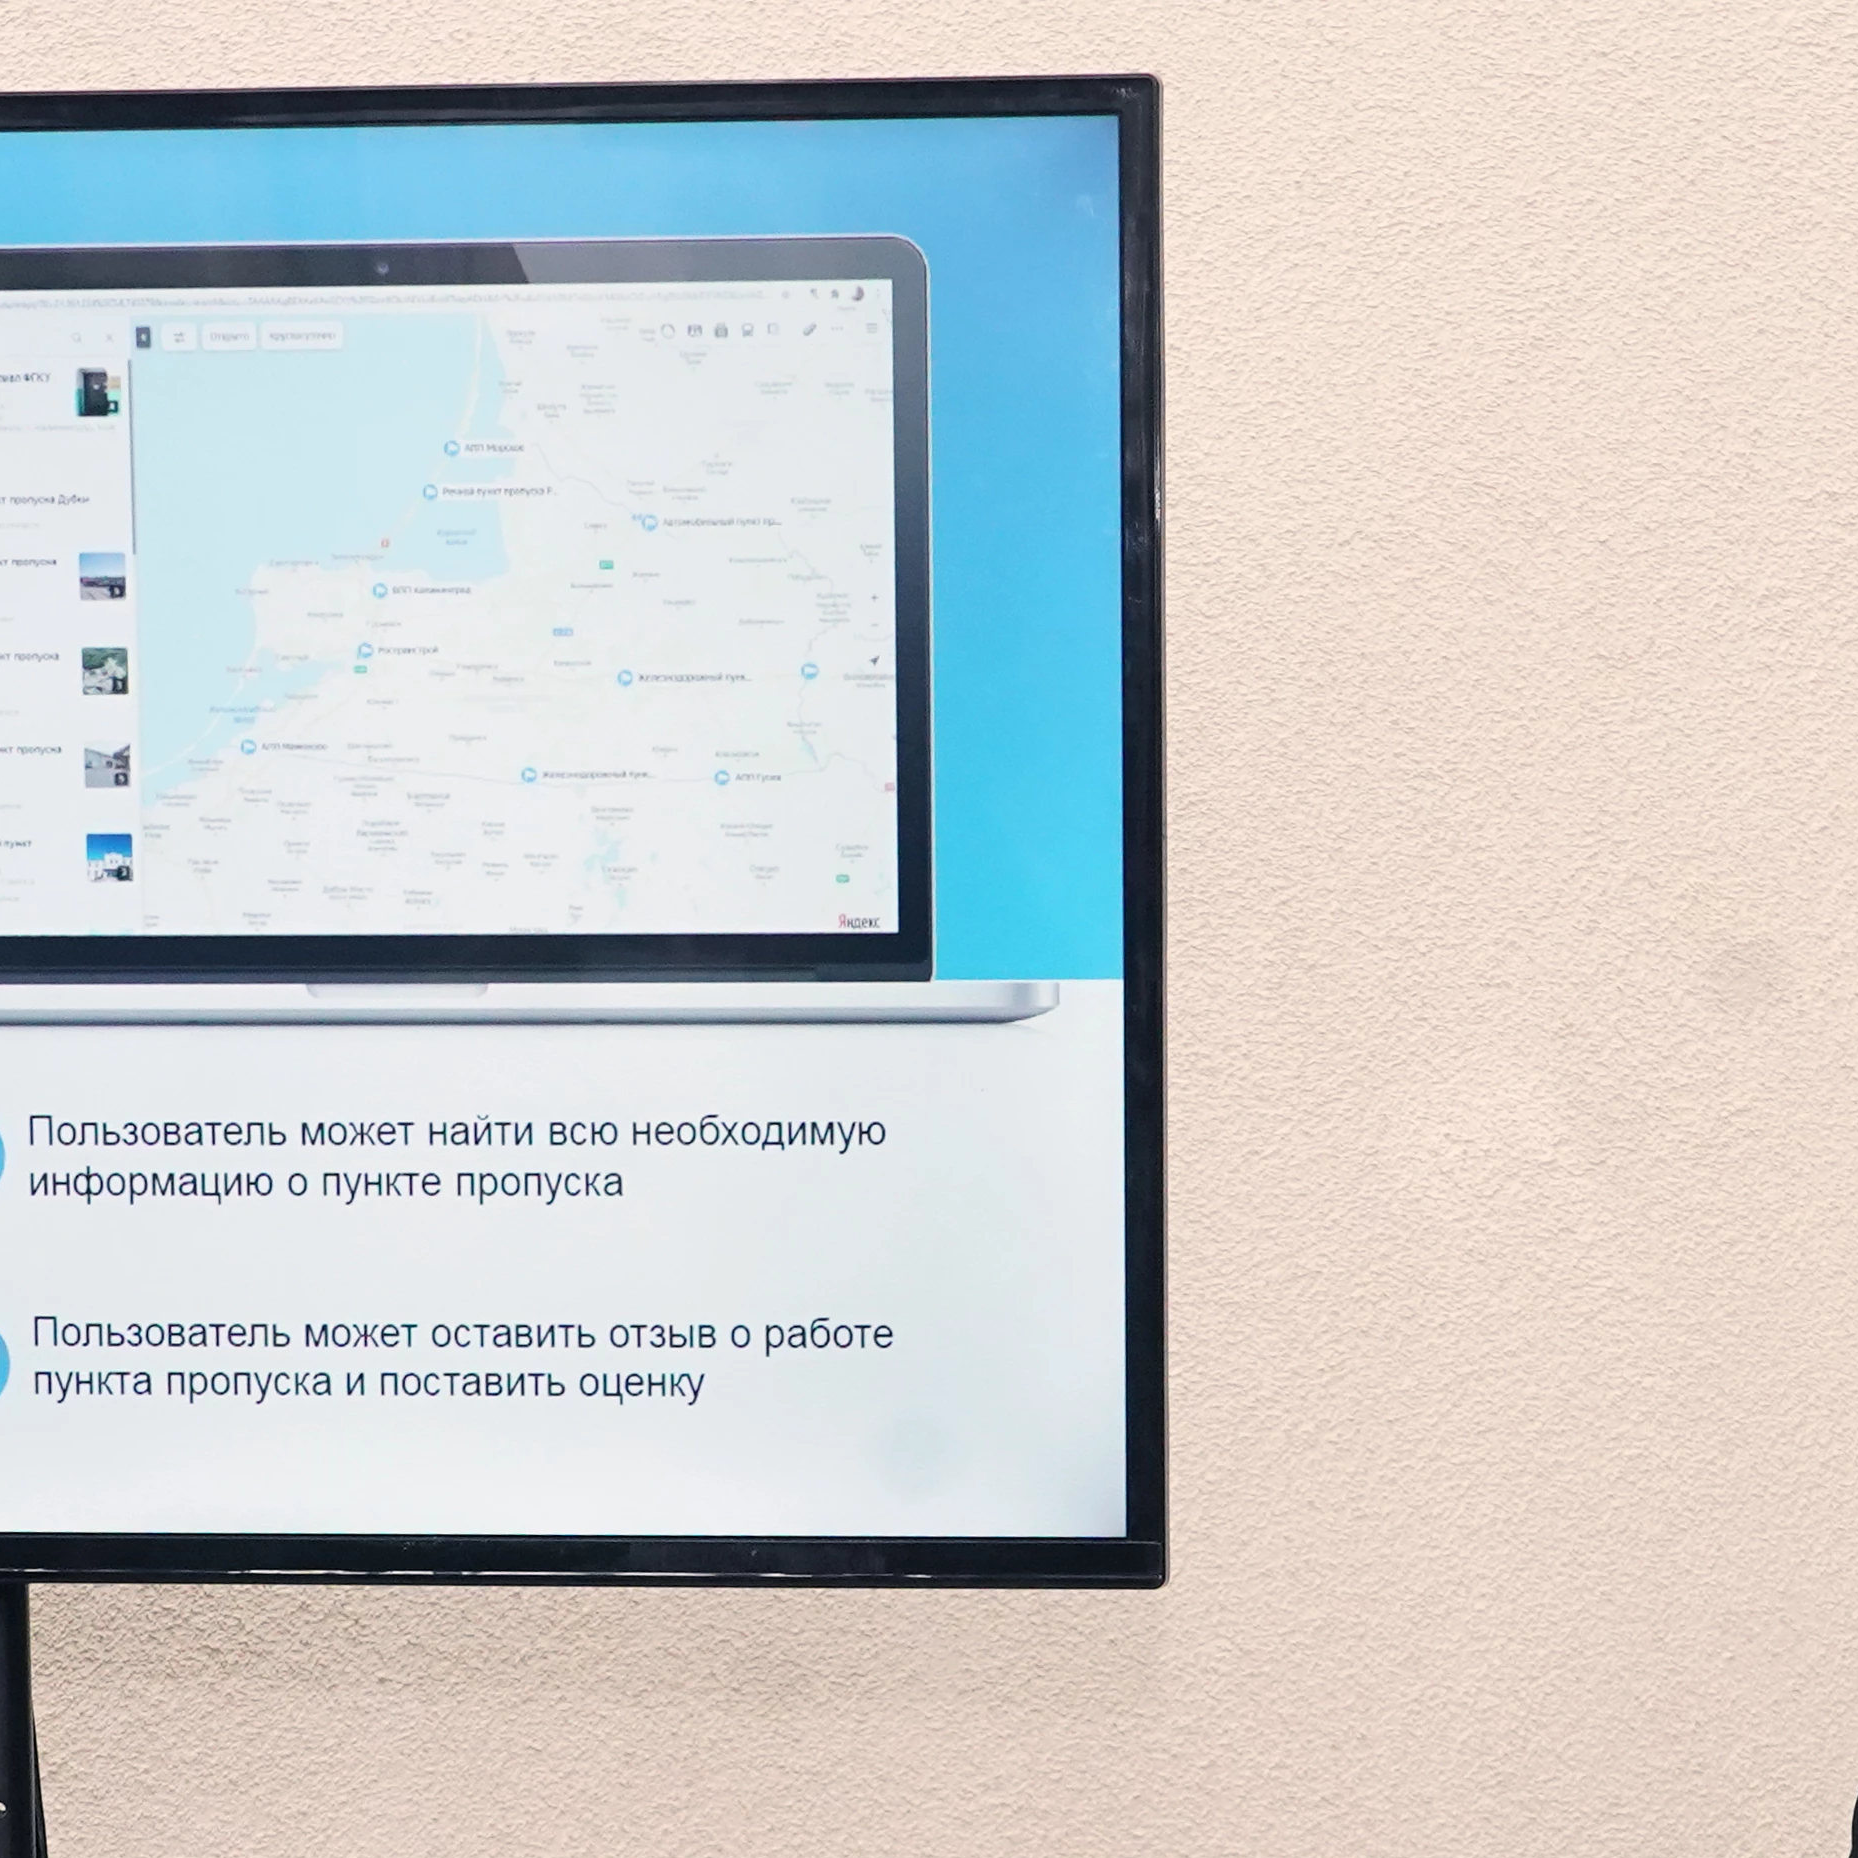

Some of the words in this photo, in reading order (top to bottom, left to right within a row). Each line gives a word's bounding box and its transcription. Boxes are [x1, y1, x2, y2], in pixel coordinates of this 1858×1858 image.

[24, 372, 51, 384] ФГКУ
[9, 495, 56, 507] пропуска
[11, 559, 58, 568] пропуска
[13, 652, 60, 663] пропуска
[16, 746, 63, 756] пропуска
[837, 913, 881, 931] Яндекс
[29, 1114, 287, 1147] Пользователь
[301, 1121, 415, 1146] может
[428, 1114, 533, 1146] найти
[549, 1121, 618, 1146] всю
[632, 1114, 886, 1155] необходимую
[30, 1165, 274, 1206] информацию
[287, 1172, 308, 1197] о
[322, 1172, 442, 1206] пункте
[456, 1172, 623, 1206] пропуска
[33, 1315, 291, 1348] Пользователь
[304, 1323, 418, 1348] может
[431, 1323, 596, 1349] оставить
[609, 1324, 717, 1349] отзыв
[730, 1324, 751, 1349] о
[765, 1317, 894, 1358] работе
[34, 1371, 152, 1404] пункта
[167, 1371, 332, 1405] пропуска
[346, 1372, 365, 1396] и
[380, 1372, 566, 1397] поставить
[579, 1372, 705, 1406] оценку
